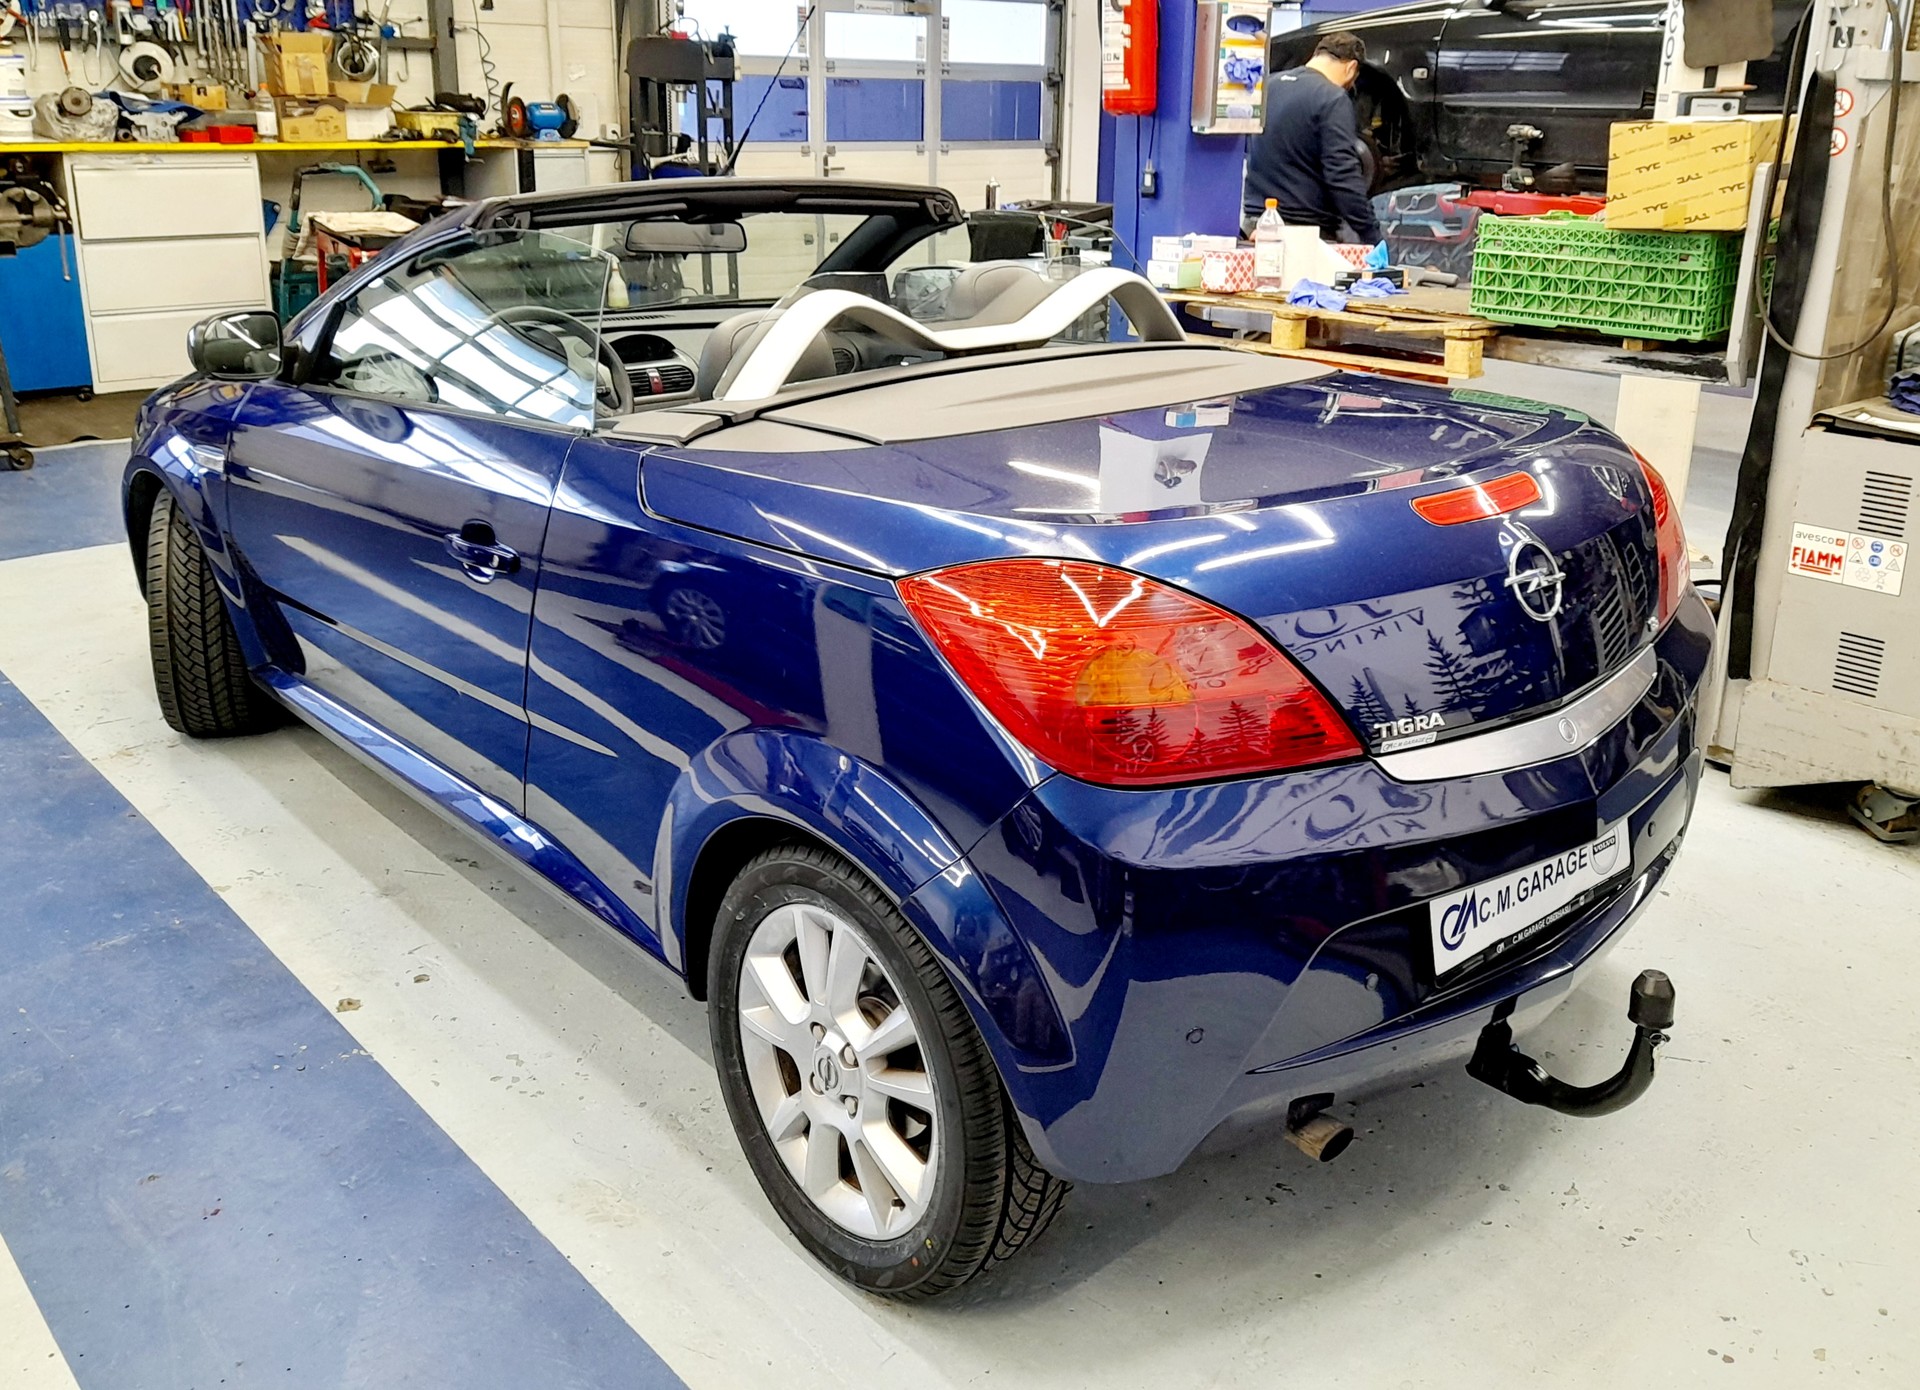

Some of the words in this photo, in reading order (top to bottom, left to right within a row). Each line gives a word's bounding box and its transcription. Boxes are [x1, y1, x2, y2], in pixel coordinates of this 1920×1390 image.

[1628, 123, 1654, 134] TYC
[1669, 132, 1695, 144] TYC
[1712, 141, 1738, 153] TYC
[1635, 162, 1661, 174] TYC
[1676, 173, 1703, 185] TYC
[1719, 182, 1746, 194] TYC
[1643, 202, 1669, 214] TYC
[1684, 213, 1710, 225] TYC
[1795, 531, 1835, 545] avesco
[1792, 546, 1843, 571] FIAMM
[1373, 712, 1445, 738] TIGRA
[1593, 836, 1616, 853] VOLVO
